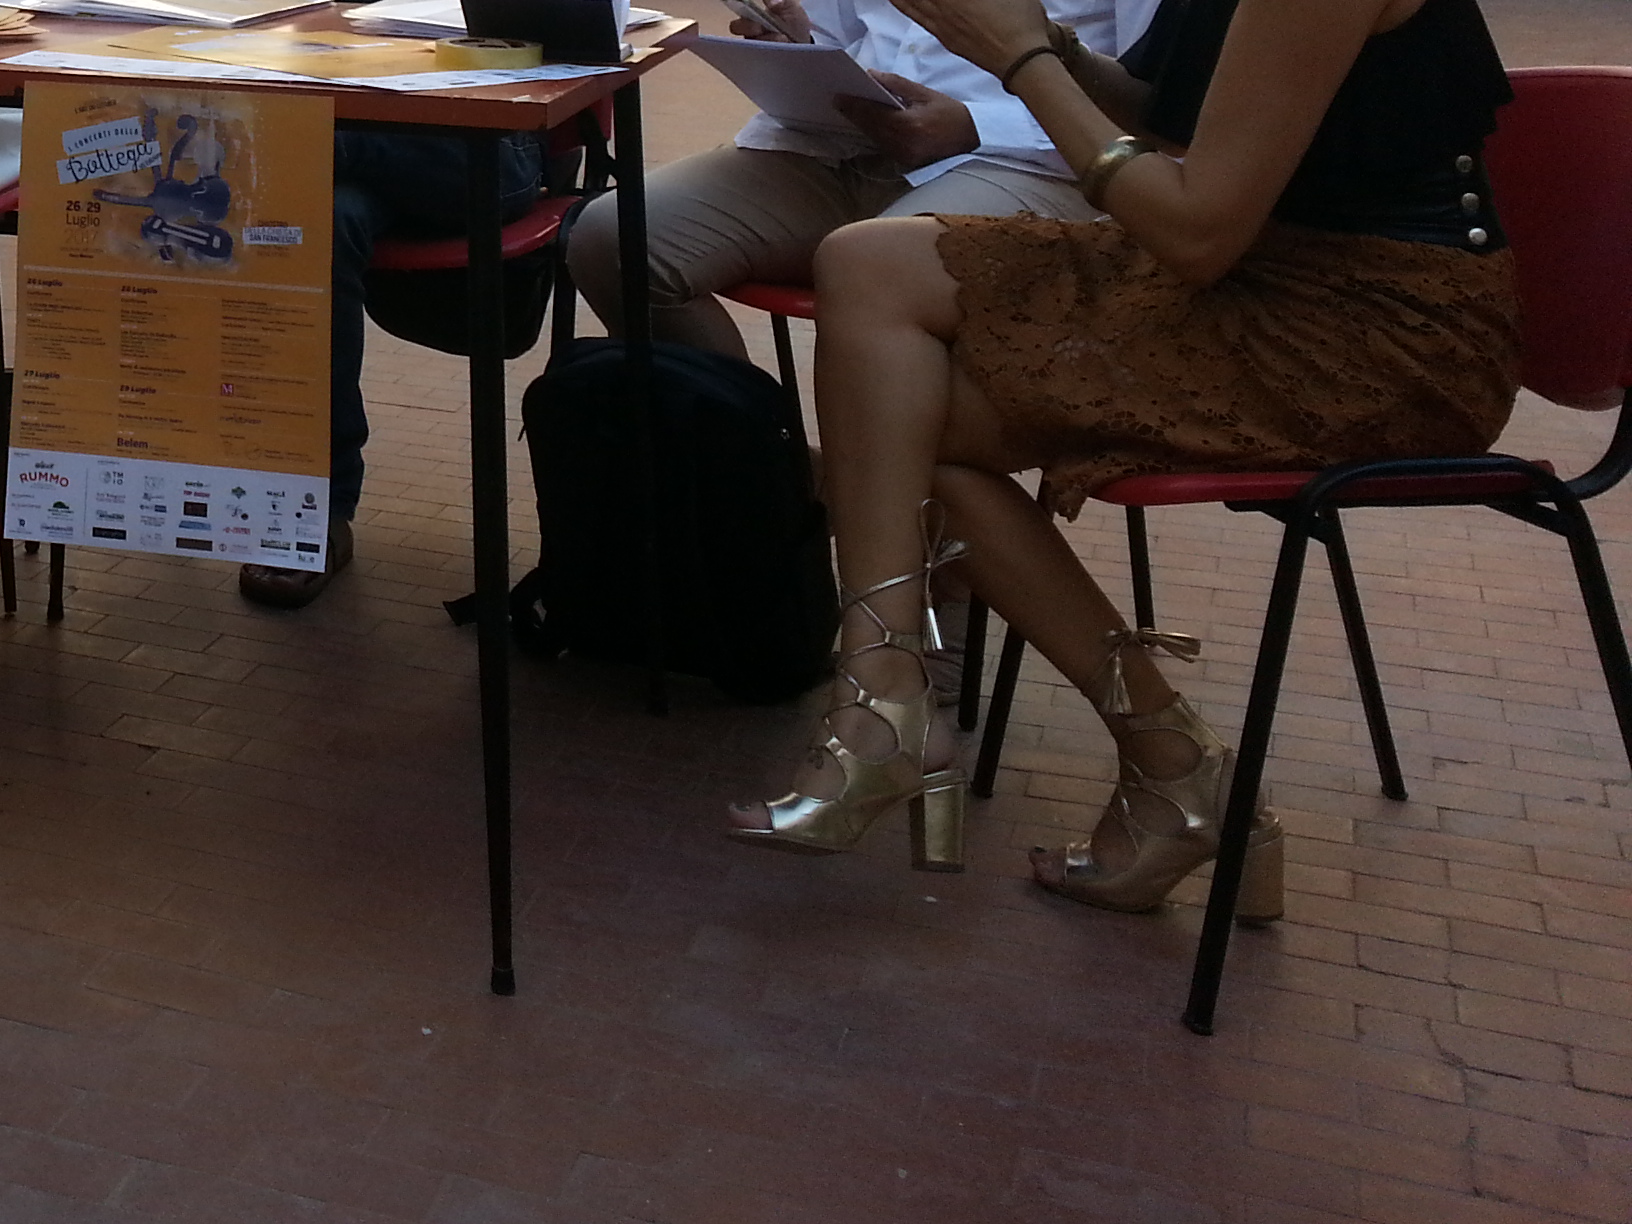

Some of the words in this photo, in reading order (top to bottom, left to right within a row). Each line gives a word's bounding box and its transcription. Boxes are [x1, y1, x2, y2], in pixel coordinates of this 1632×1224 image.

[74, 130, 111, 149] CONCERTI
[114, 128, 139, 136] DELLA
[66, 142, 153, 184] Bottega
[66, 200, 81, 212] 26
[86, 201, 101, 213] 29
[66, 212, 101, 228] Luglio
[38, 279, 63, 287] Luglio
[132, 286, 158, 295] Luglio
[35, 370, 61, 380] Luglio
[131, 386, 157, 394] Luglio
[117, 437, 148, 449] Belem
[19, 471, 70, 487] RUMMO
